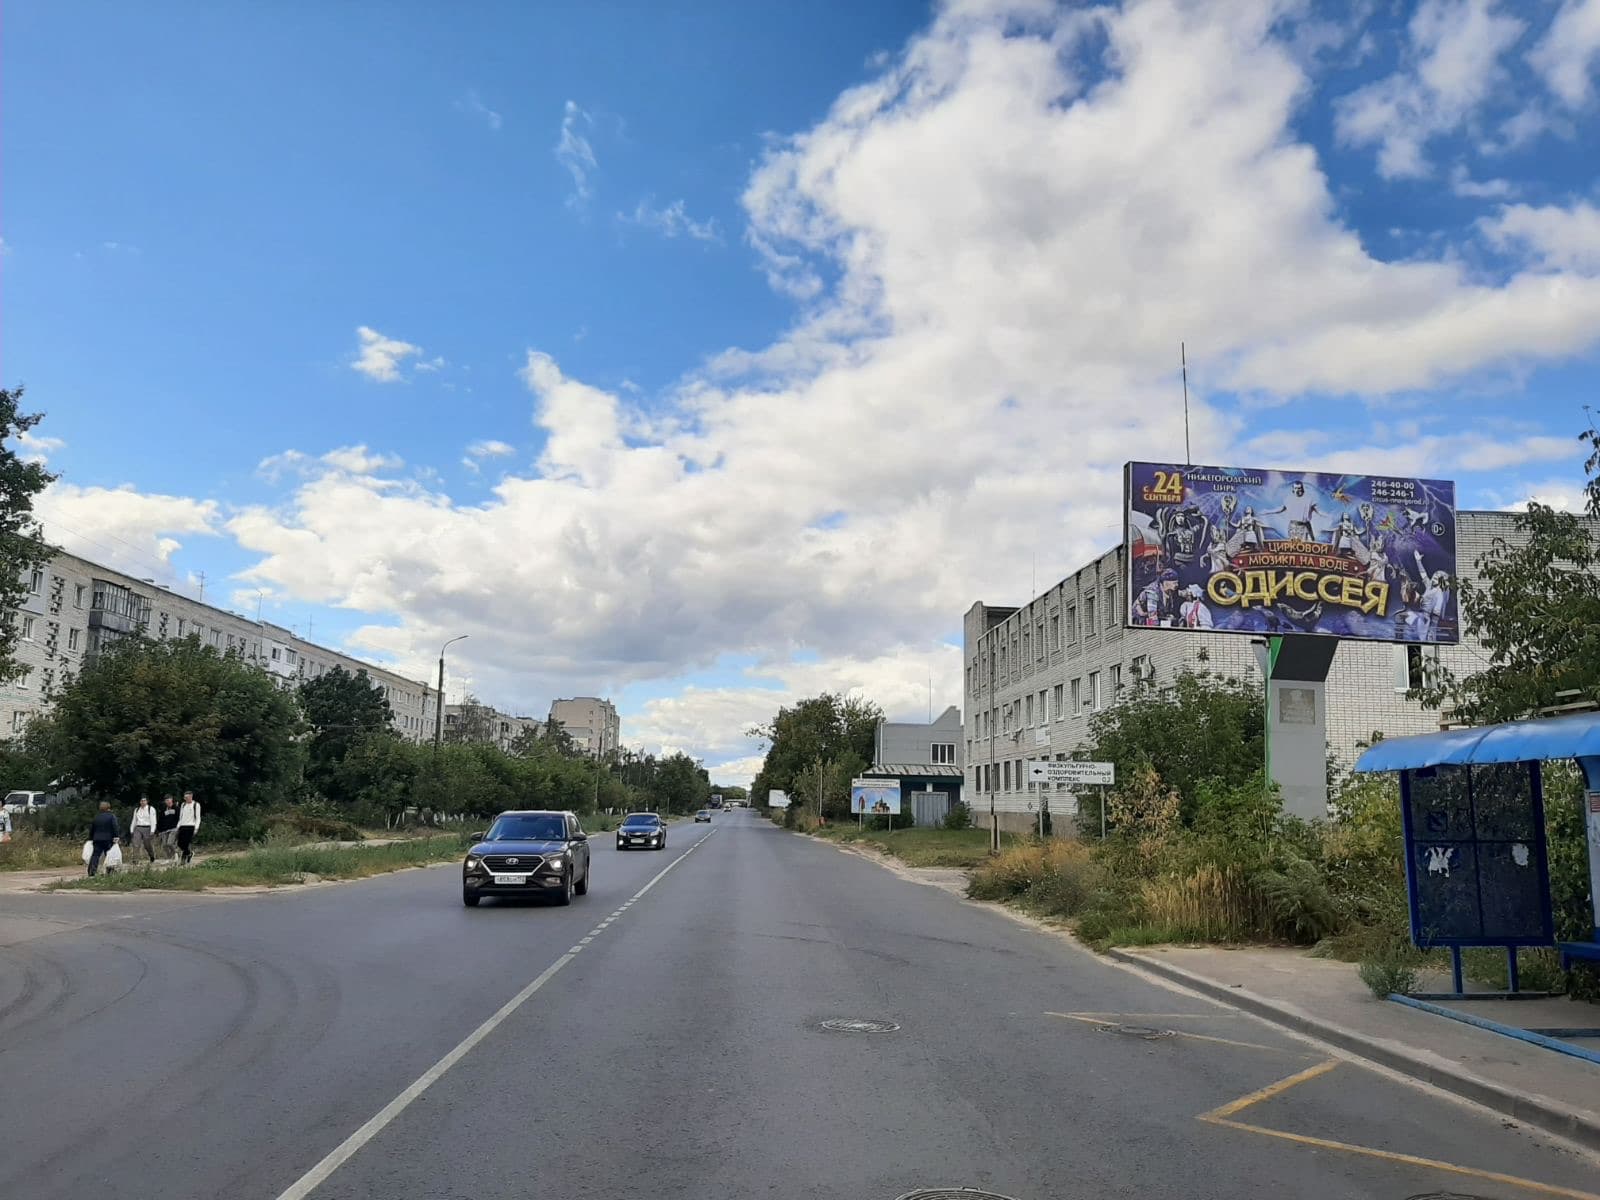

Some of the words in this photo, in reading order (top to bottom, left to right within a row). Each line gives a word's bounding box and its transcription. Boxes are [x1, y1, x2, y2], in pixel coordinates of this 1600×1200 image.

[1153, 471, 1182, 493] 24
[1187, 473, 1262, 484] НИЖЕГОРОДСКИЙ
[1213, 484, 1237, 493] ЦИРК
[1371, 480, 1415, 489] 246-40-00
[1143, 493, 1182, 502] СЕНТЯБРЯ
[1371, 489, 1414, 498] 246-246-1
[1268, 542, 1329, 555] ЦИРКОВОЙ
[1249, 556, 1296, 566] МЮЗИКЛ
[1300, 557, 1315, 567] НА
[1319, 559, 1350, 571] ВОДЕ
[1207, 570, 1390, 616] ОДИССЕЯ
